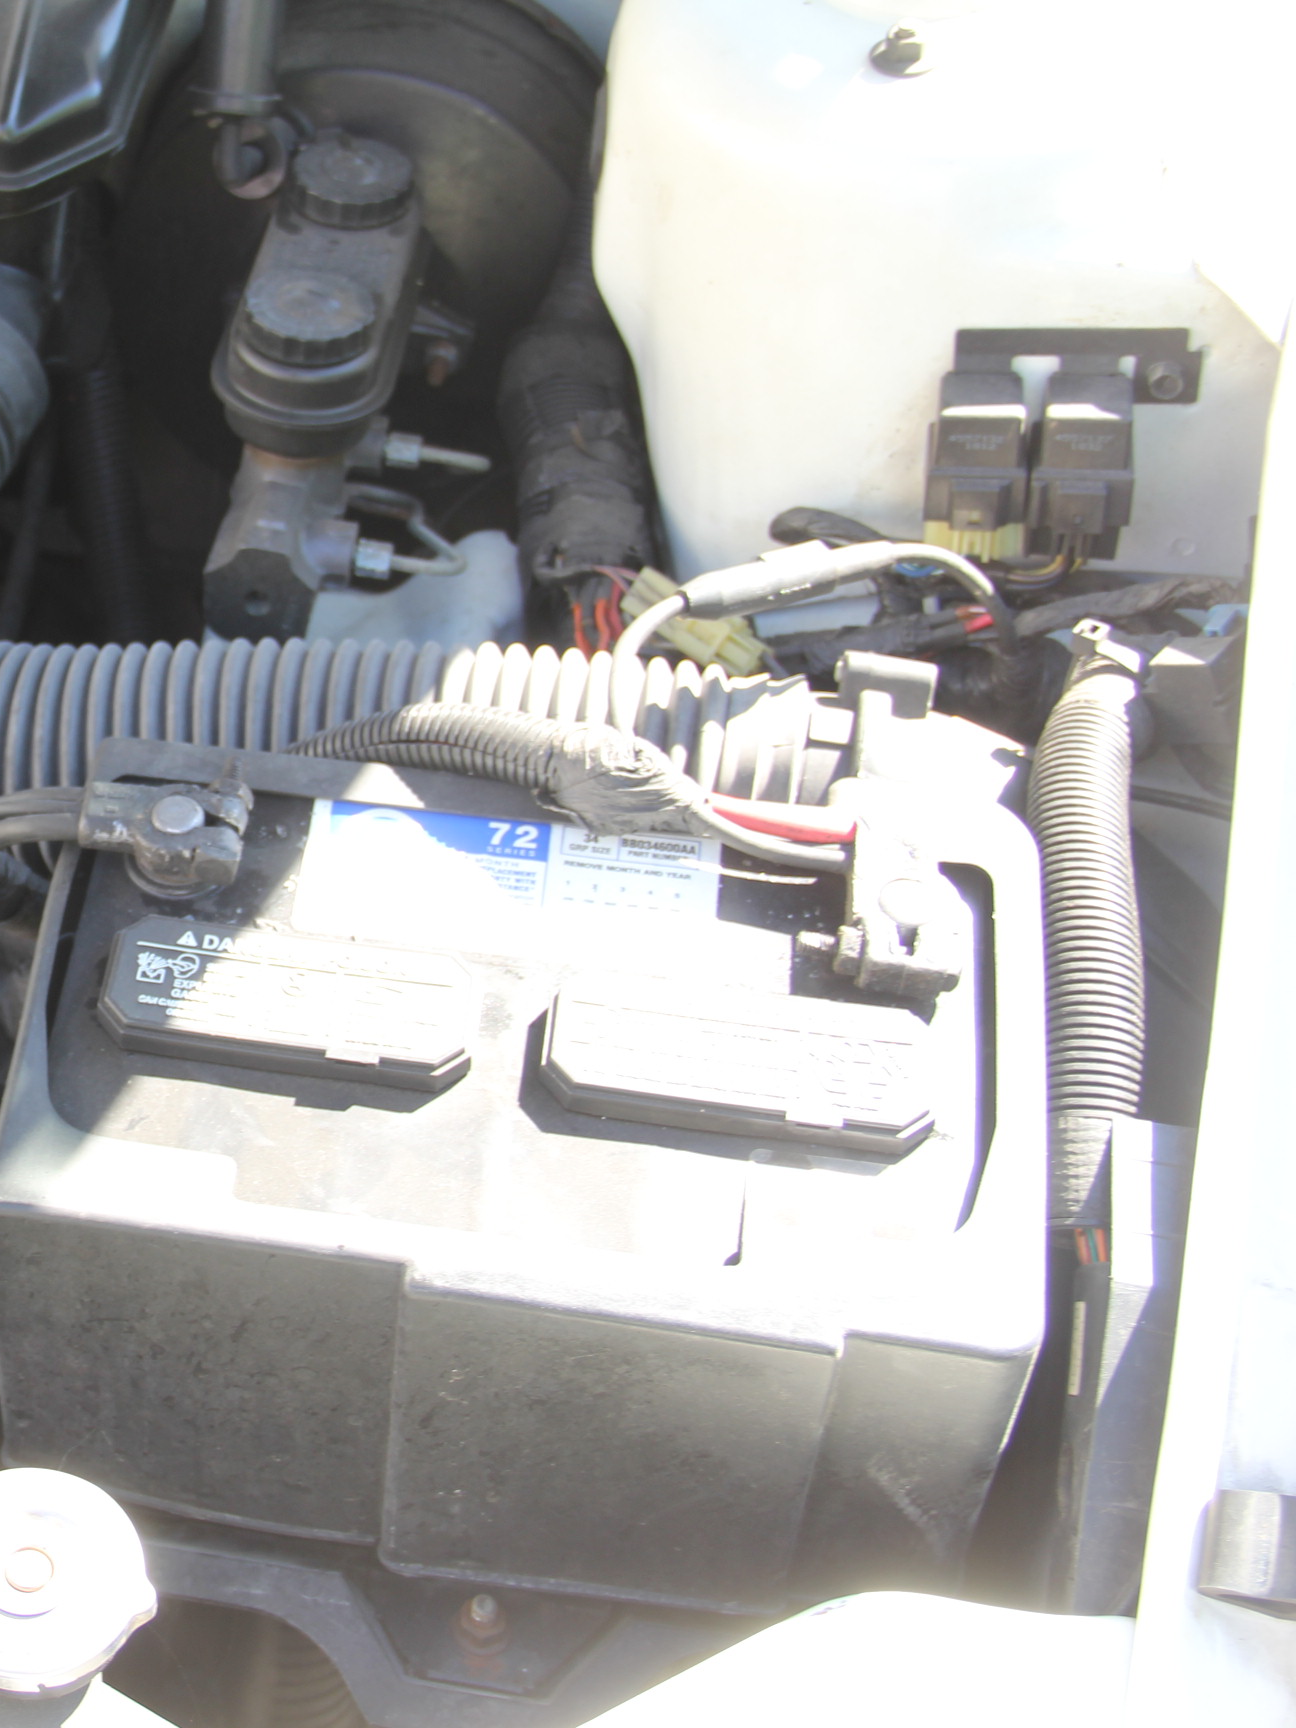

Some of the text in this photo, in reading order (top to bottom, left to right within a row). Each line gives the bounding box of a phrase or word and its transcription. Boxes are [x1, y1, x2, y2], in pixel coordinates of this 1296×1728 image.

[488, 822, 539, 849] 72
[487, 846, 536, 857] SERIES
[591, 846, 612, 855] SIZE
[627, 851, 650, 859] PART
[563, 860, 692, 880] REMOVE MONTH AND YEAR
